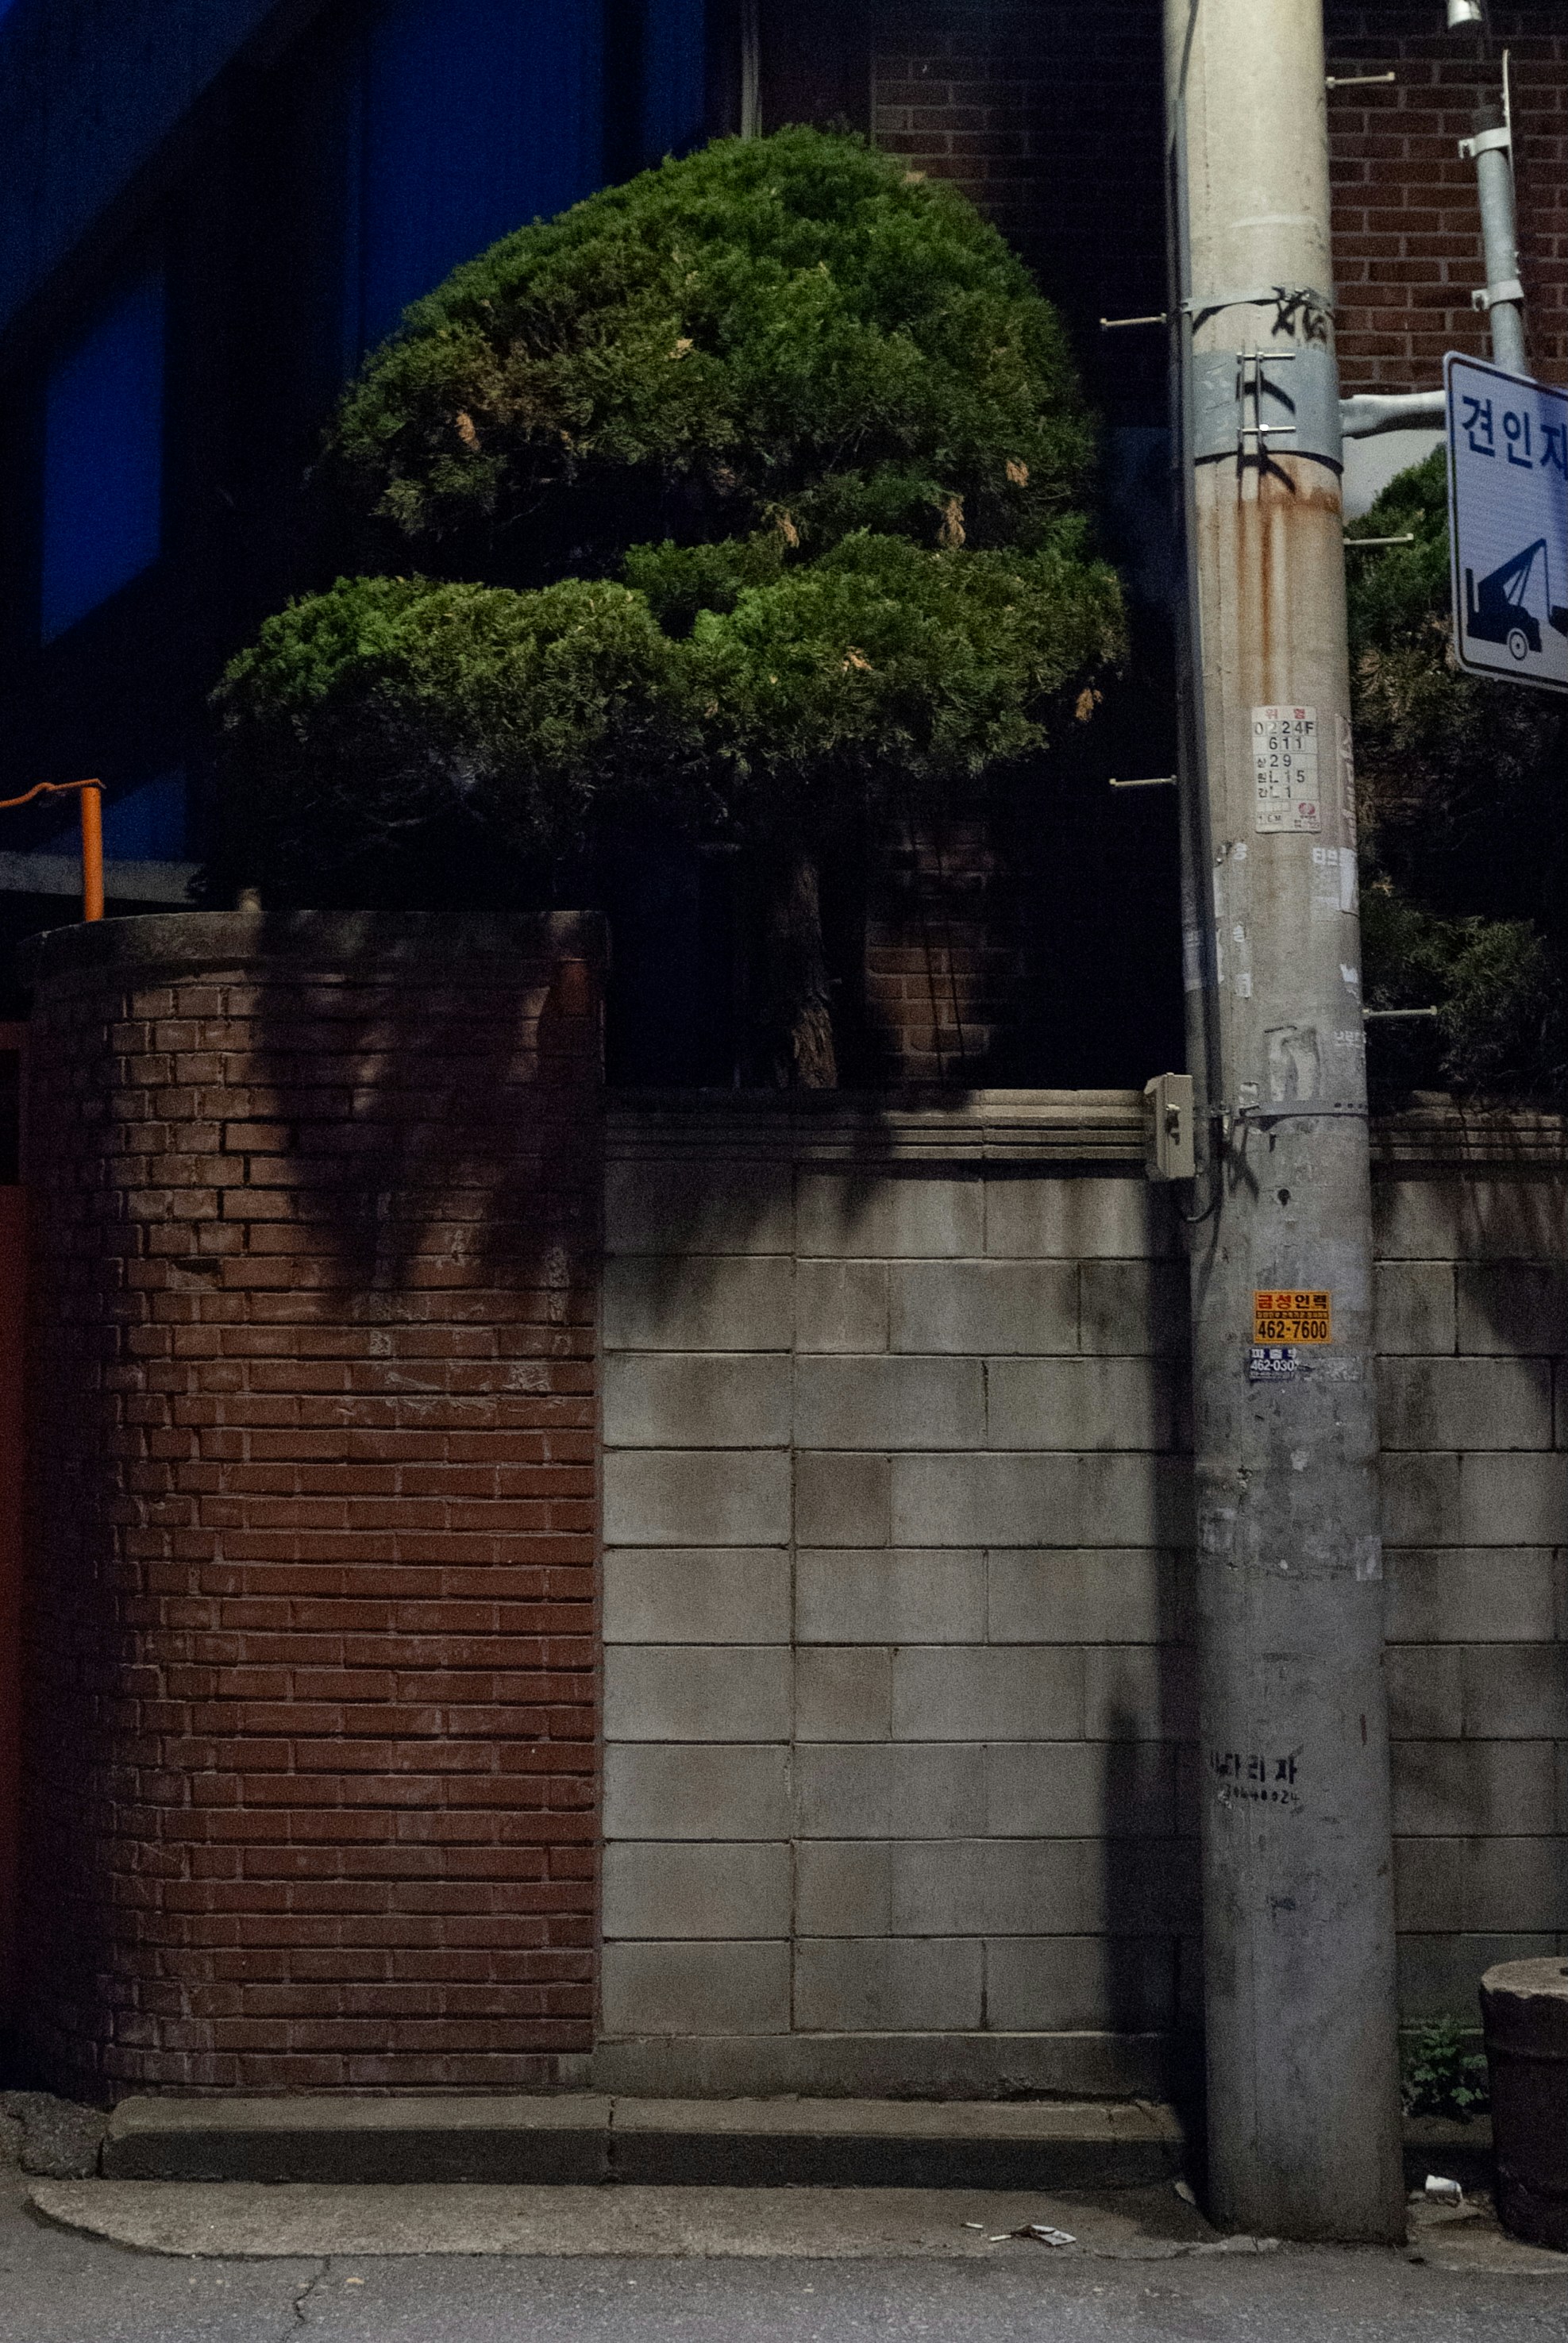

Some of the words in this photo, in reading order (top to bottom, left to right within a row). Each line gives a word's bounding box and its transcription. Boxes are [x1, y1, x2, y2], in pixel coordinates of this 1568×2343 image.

[1254, 721, 1314, 735] 0224F
[1269, 737, 1302, 750] 611
[1269, 754, 1292, 767] 29
[1258, 1320, 1327, 1339] 462-7600
